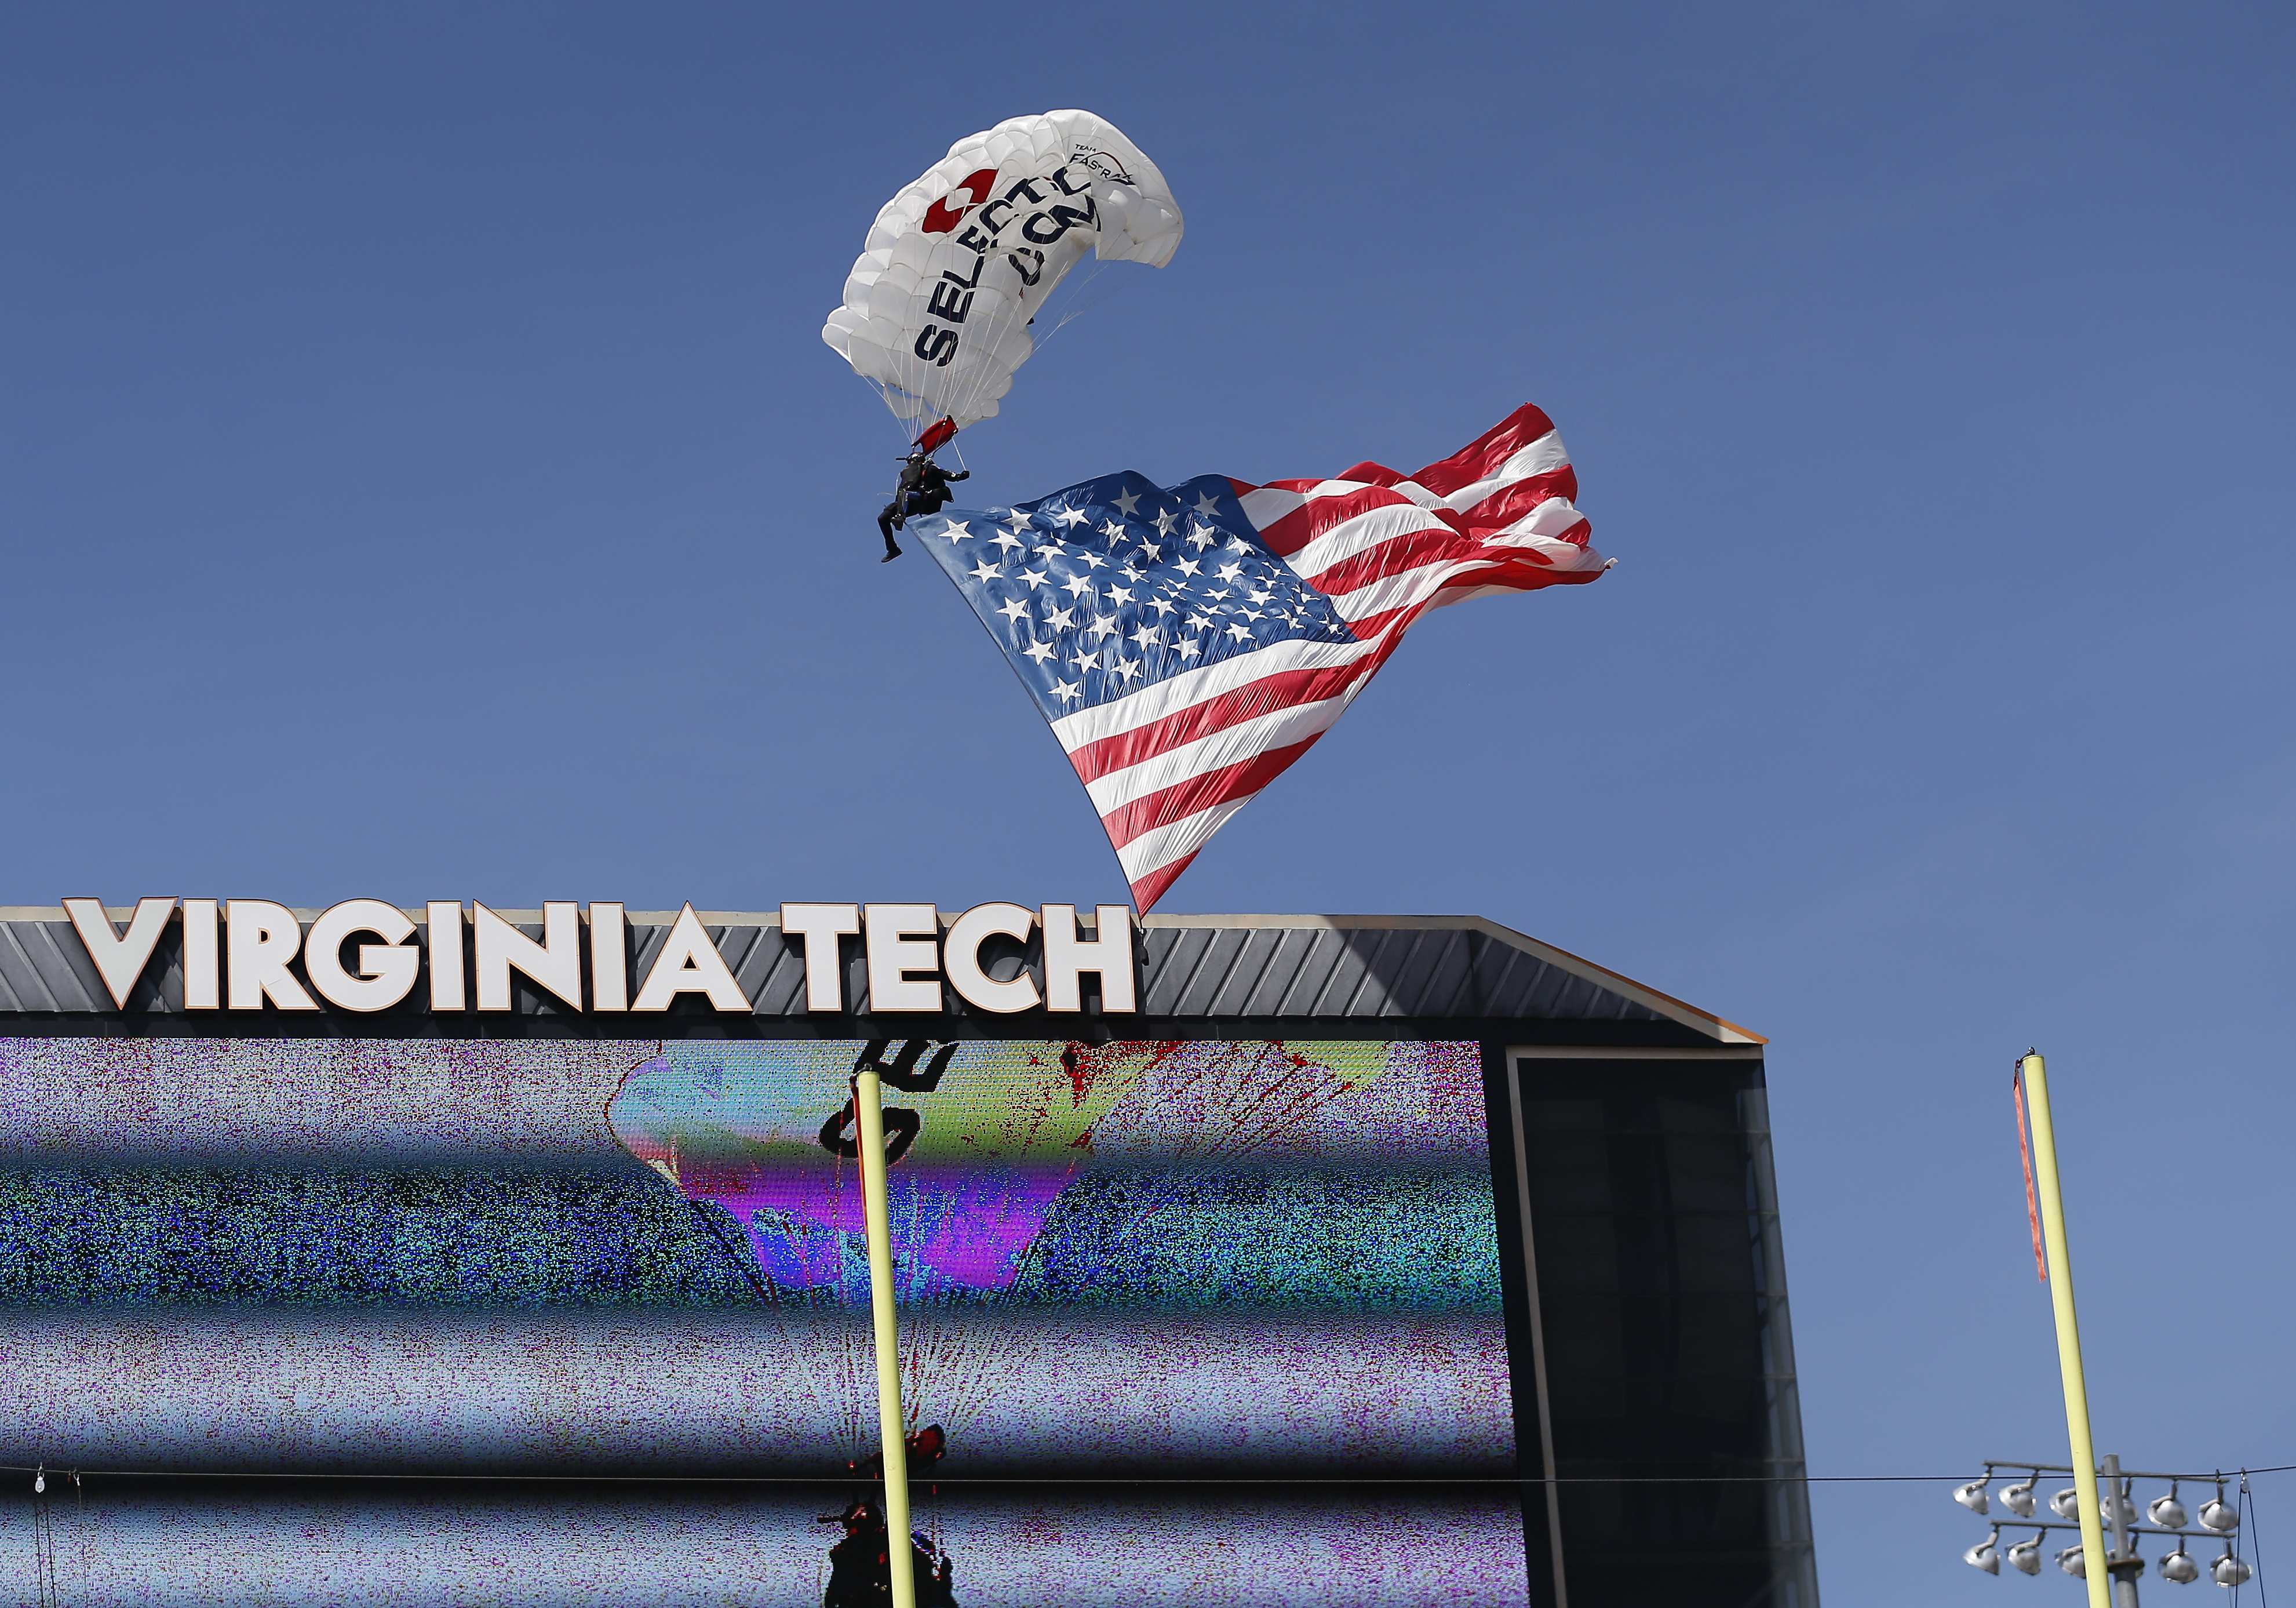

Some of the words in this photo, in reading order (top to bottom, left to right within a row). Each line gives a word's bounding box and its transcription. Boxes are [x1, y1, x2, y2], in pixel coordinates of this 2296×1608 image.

[1076, 144, 1096, 152] TEAM
[61, 896, 753, 1012] VIRGINIA
[781, 901, 1136, 1013] TECH
